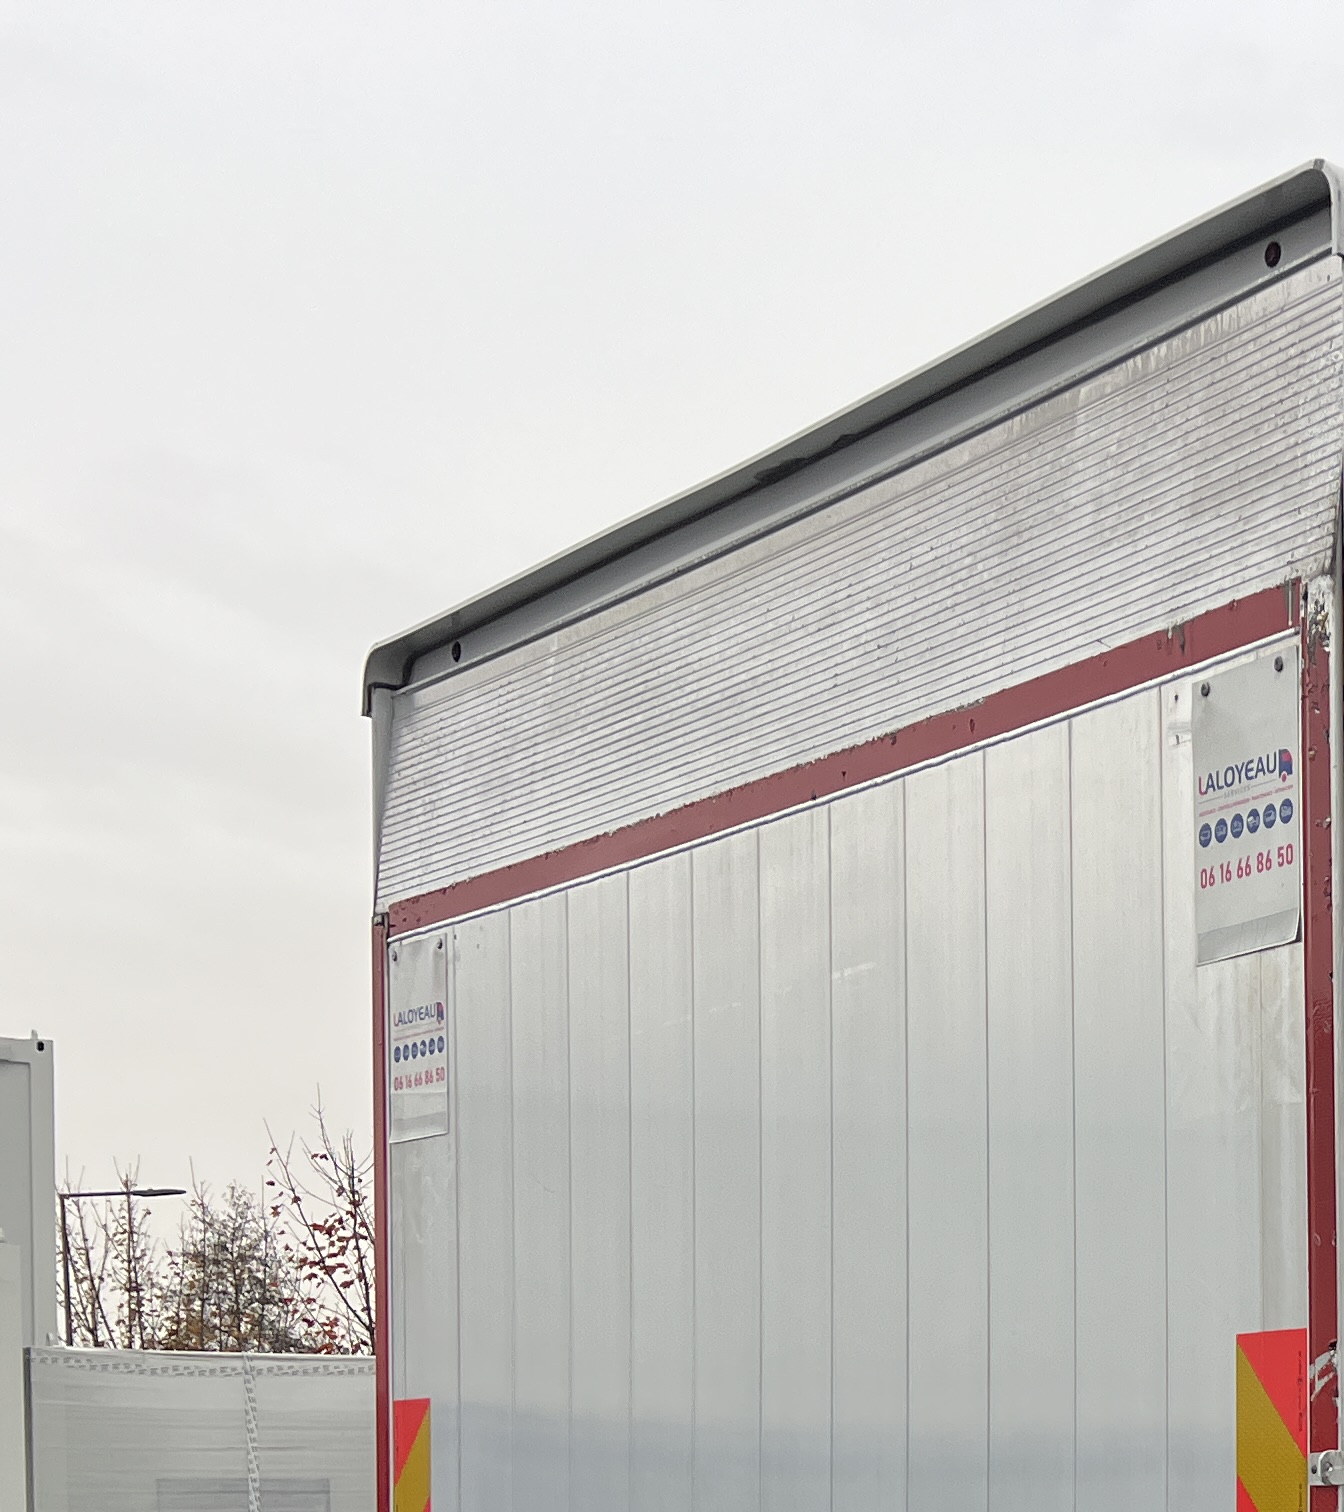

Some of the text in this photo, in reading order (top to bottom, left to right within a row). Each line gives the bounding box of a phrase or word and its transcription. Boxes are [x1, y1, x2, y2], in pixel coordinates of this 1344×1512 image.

[1198, 751, 1278, 796] LALOYEAU
[1200, 843, 1294, 889] 06 16 66 86 50
[394, 1003, 435, 1027] LALOYEAU
[394, 1076, 404, 1092] 06
[414, 1071, 423, 1087] 66
[436, 1066, 445, 1082] 50
